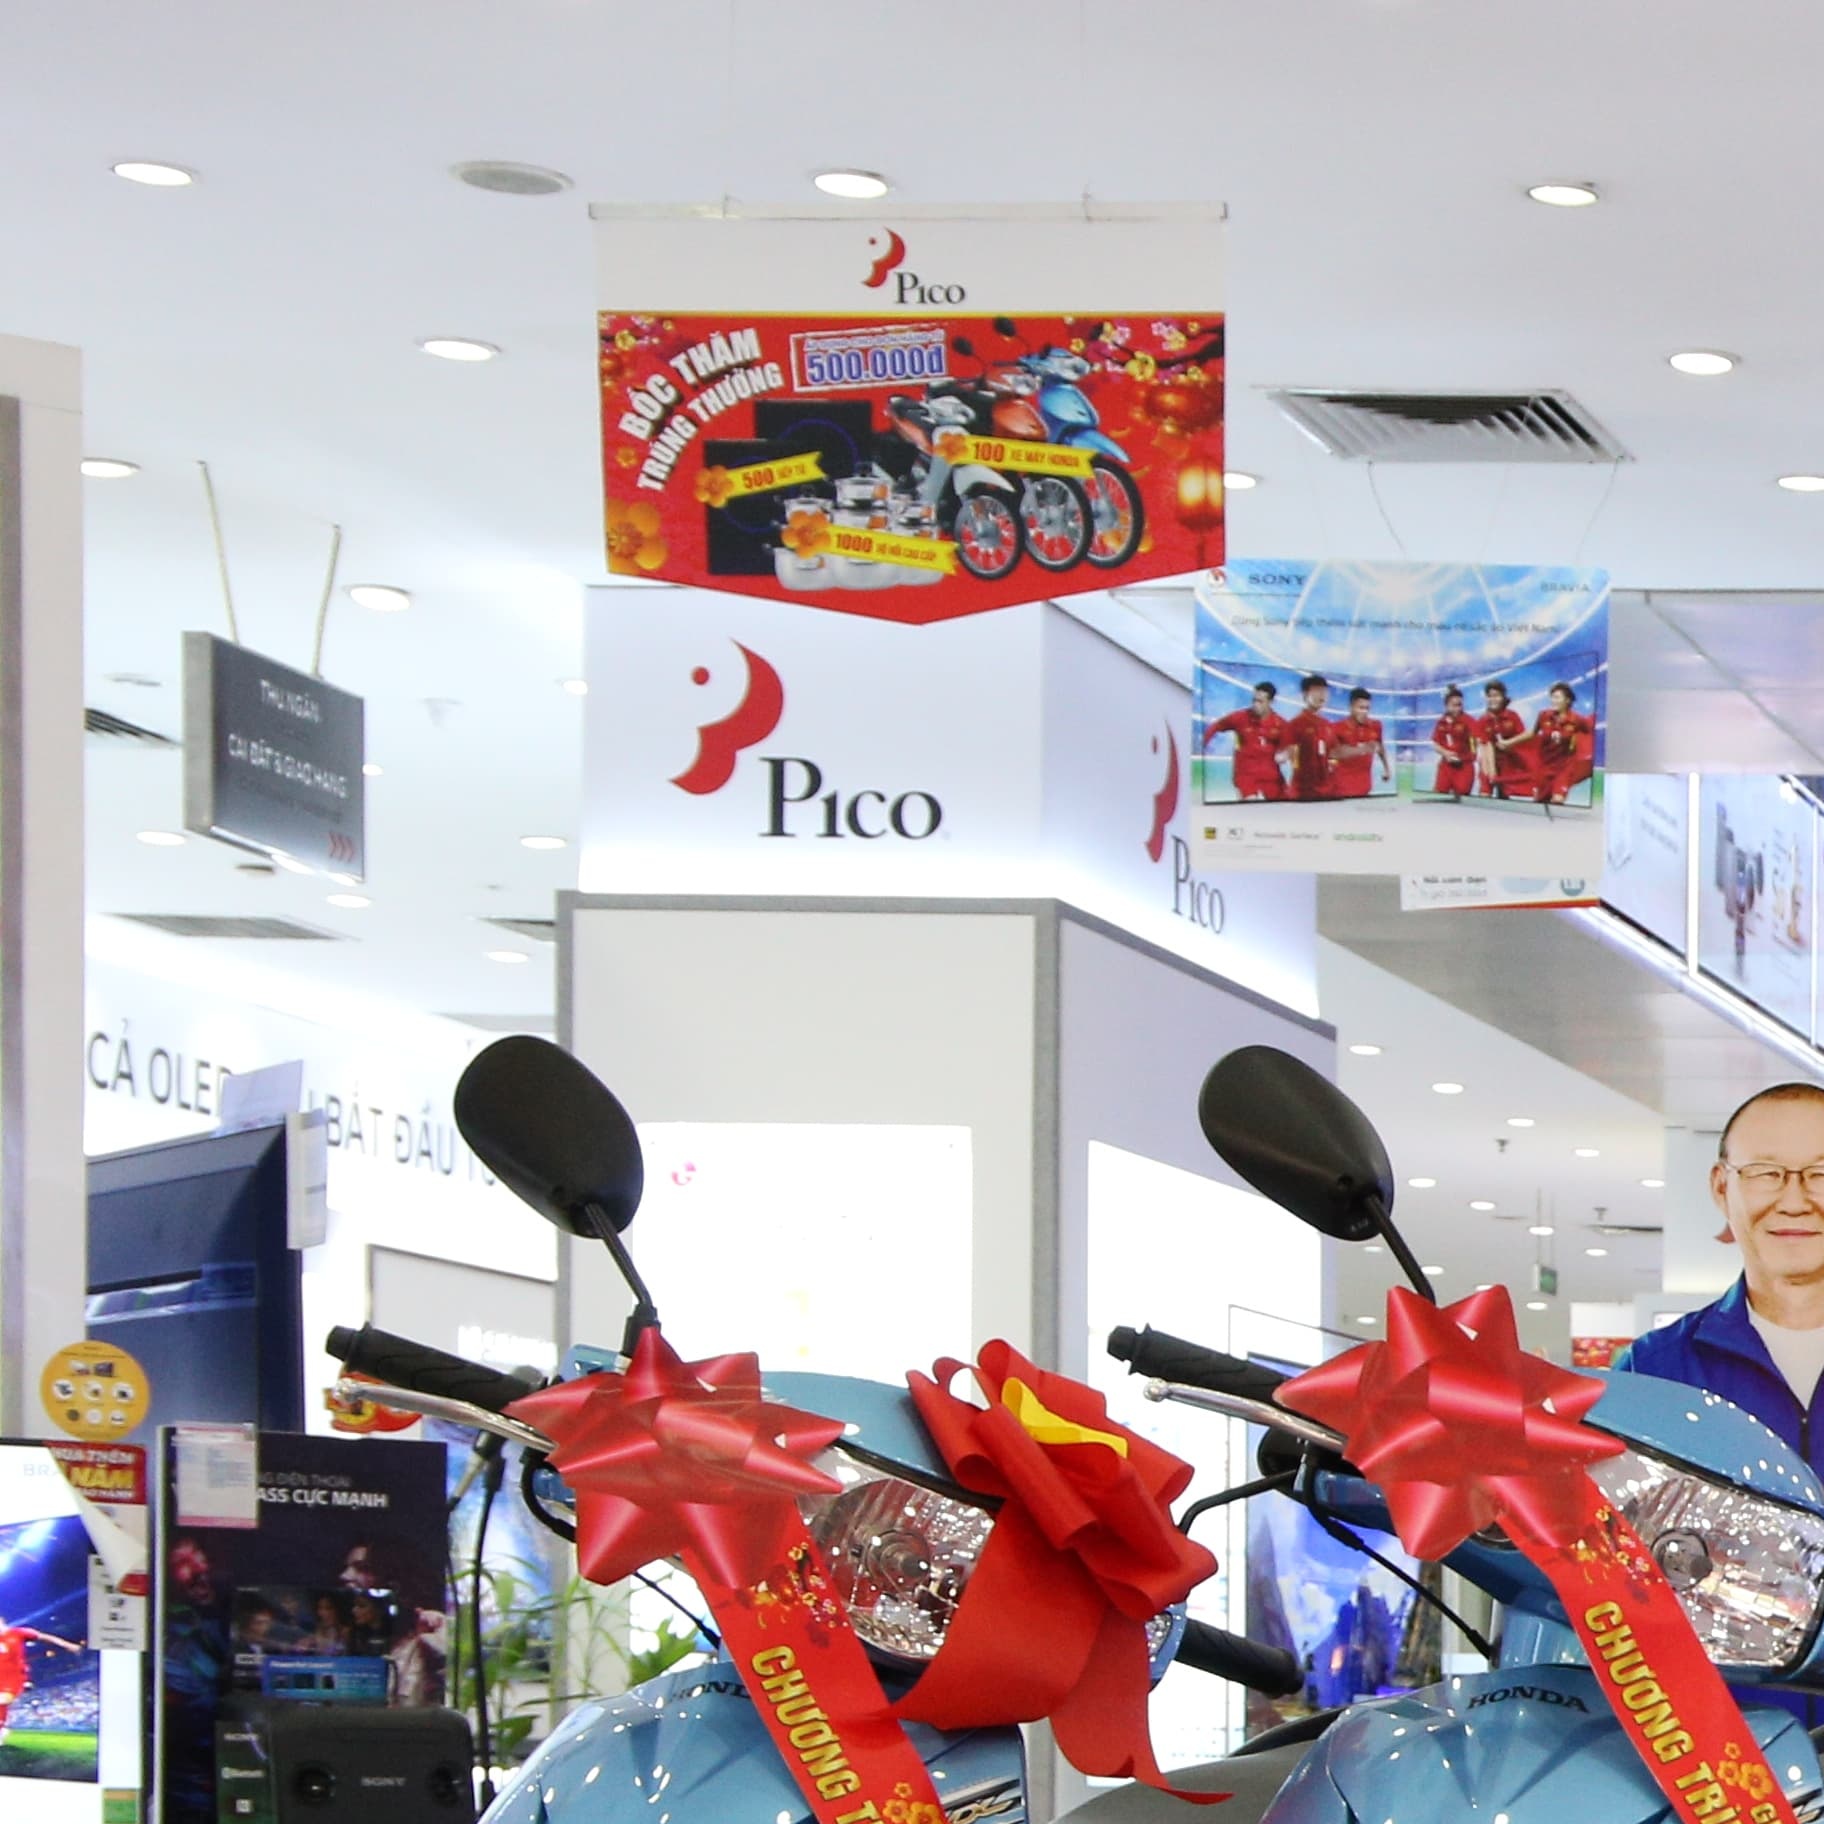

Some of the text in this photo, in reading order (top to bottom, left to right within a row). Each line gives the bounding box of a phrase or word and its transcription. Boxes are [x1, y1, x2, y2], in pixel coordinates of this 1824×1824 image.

[894, 271, 966, 304] Pico
[806, 344, 947, 385] 500.000đ
[618, 328, 763, 441] BỐC THĂM
[637, 415, 699, 492] TRÚNG
[973, 441, 1006, 463] 100
[742, 471, 775, 490] 500
[835, 533, 873, 553] 1000
[1249, 573, 1306, 586] SONY
[758, 756, 942, 841] Pico
[1172, 835, 1226, 935] Pico
[88, 1018, 138, 1097] CẢ
[70, 1462, 136, 1489] NĂM
[292, 1488, 388, 1511] CỰC MẠNH
[1584, 1600, 1696, 1763] CHƯƠNG
[1470, 1684, 1592, 1714] HONDA
[751, 1645, 862, 1802] CHƯƠNG
[361, 1776, 406, 1787] SONY
